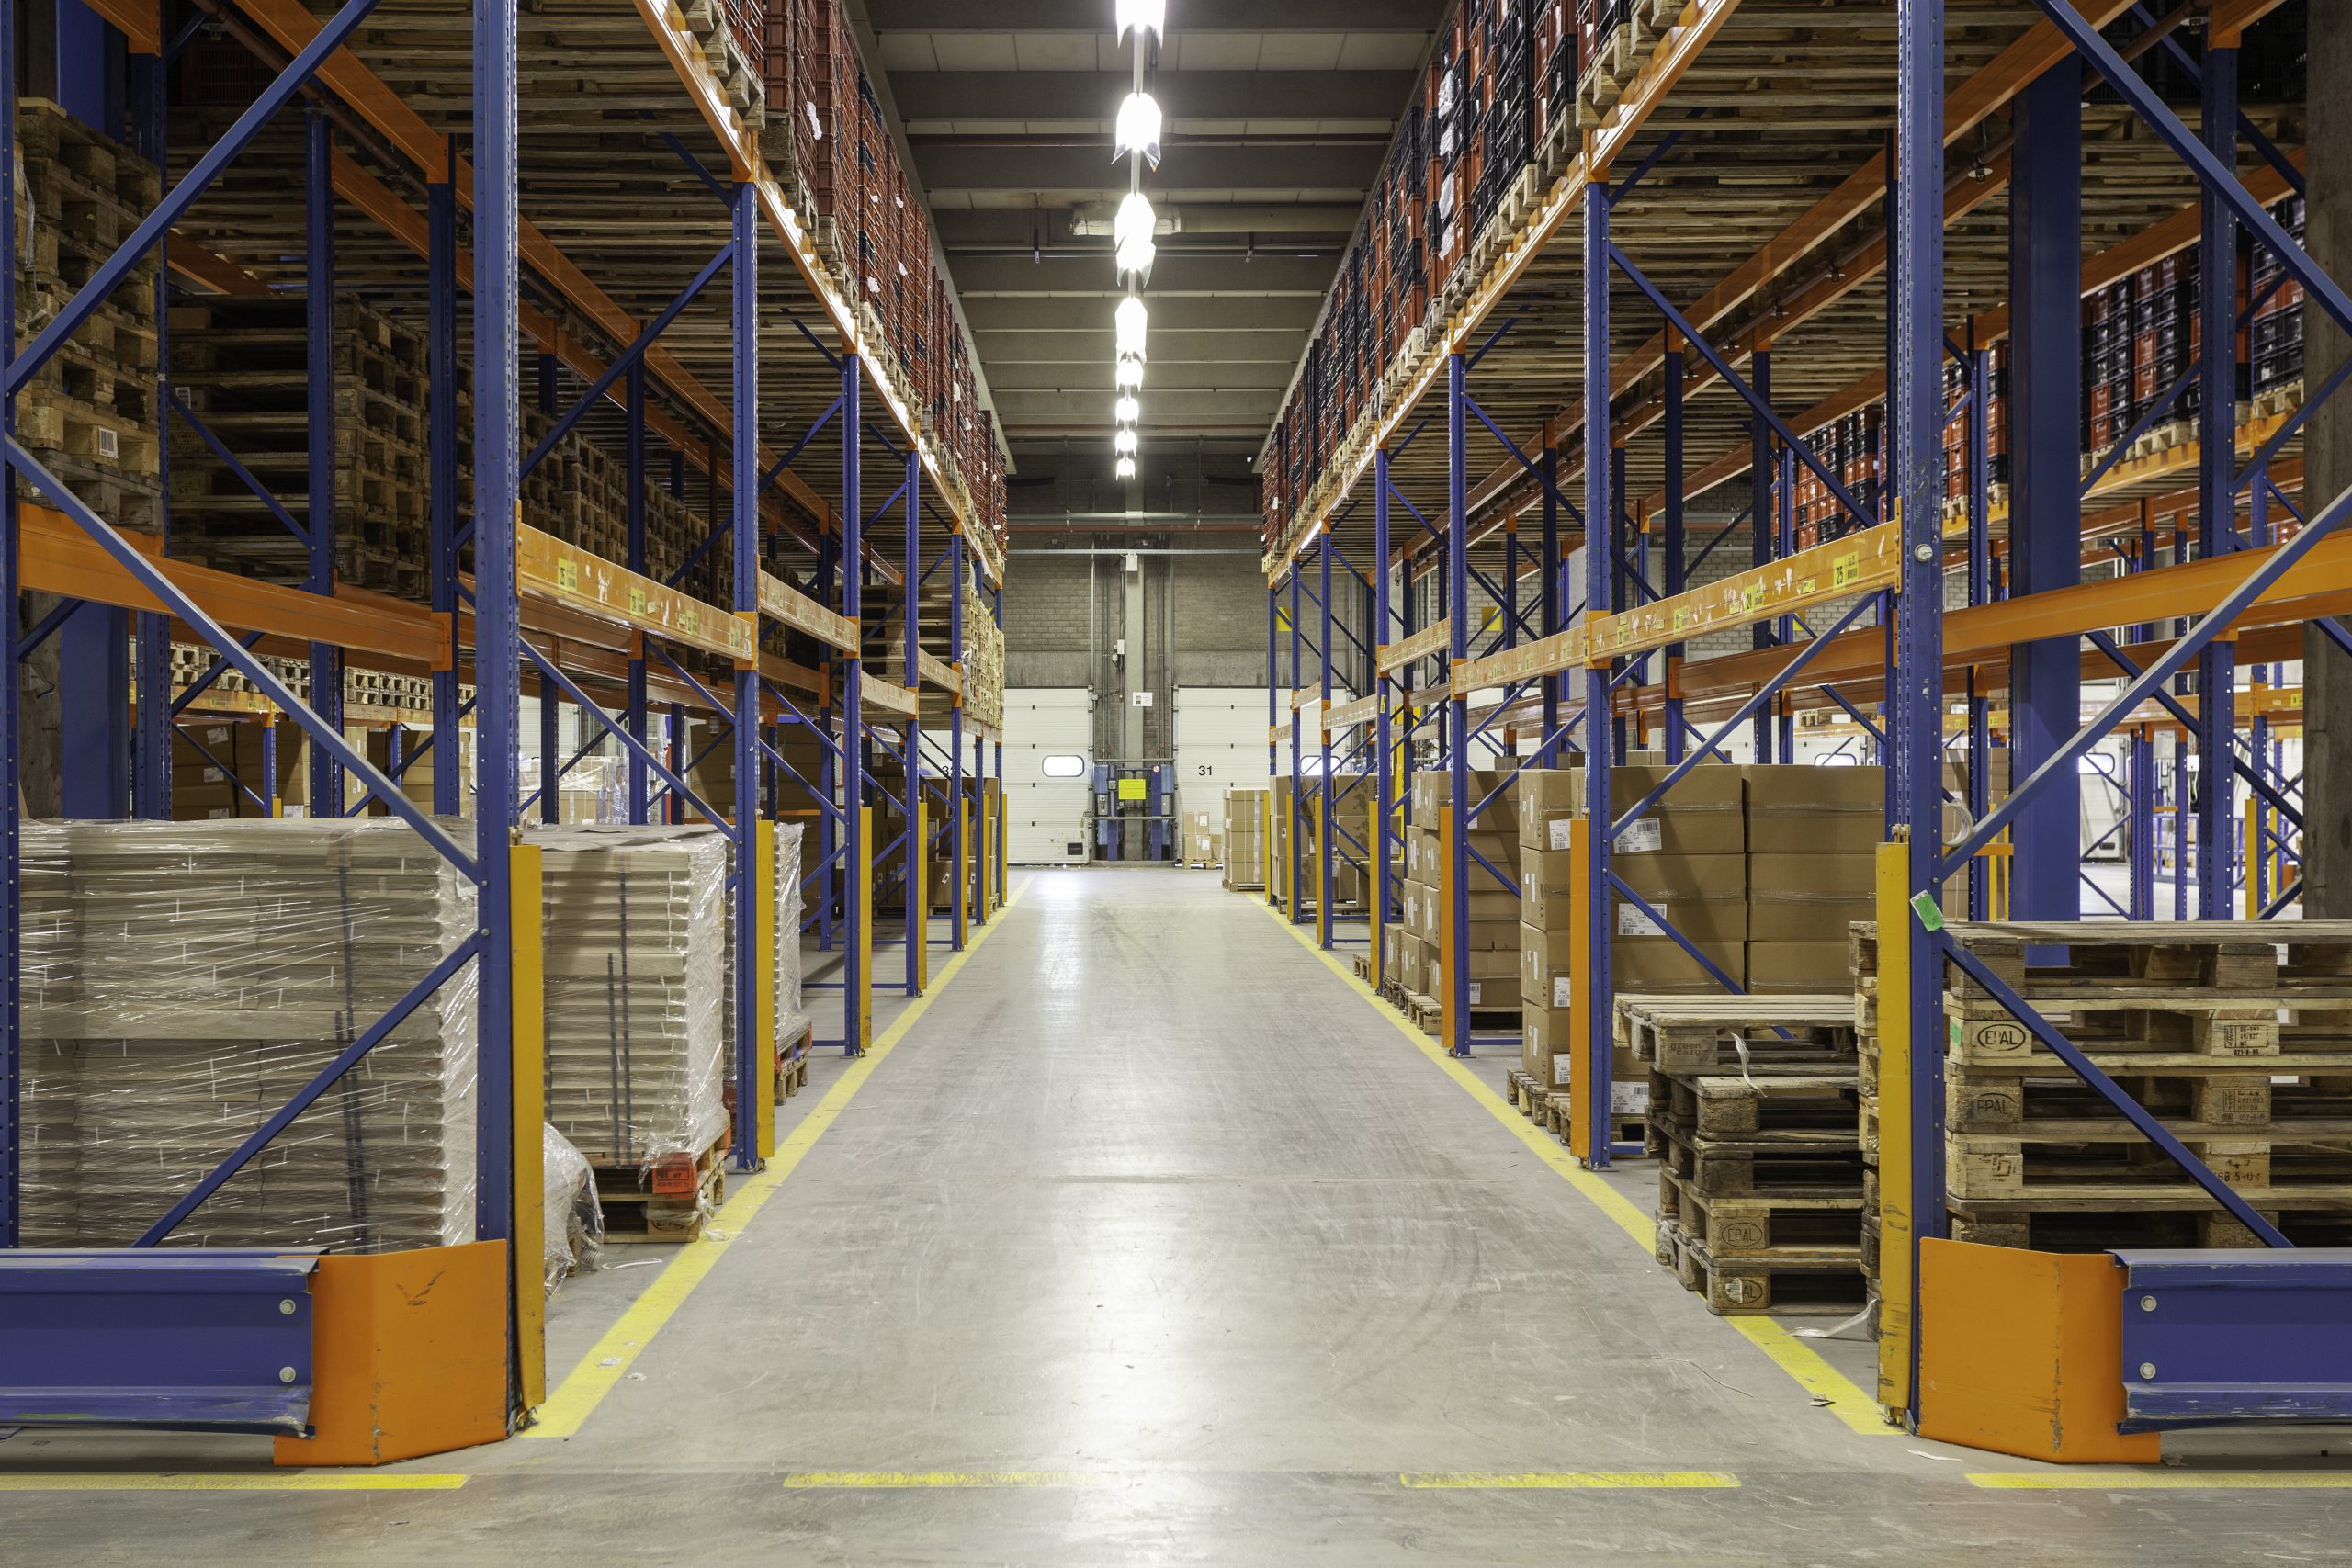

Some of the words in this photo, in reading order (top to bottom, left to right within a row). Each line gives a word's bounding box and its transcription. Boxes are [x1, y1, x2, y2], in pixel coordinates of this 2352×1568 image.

[1198, 765, 1212, 776] 31
[1984, 1030, 2018, 1045] EPAL
[1727, 1228, 1756, 1242] EPAL
